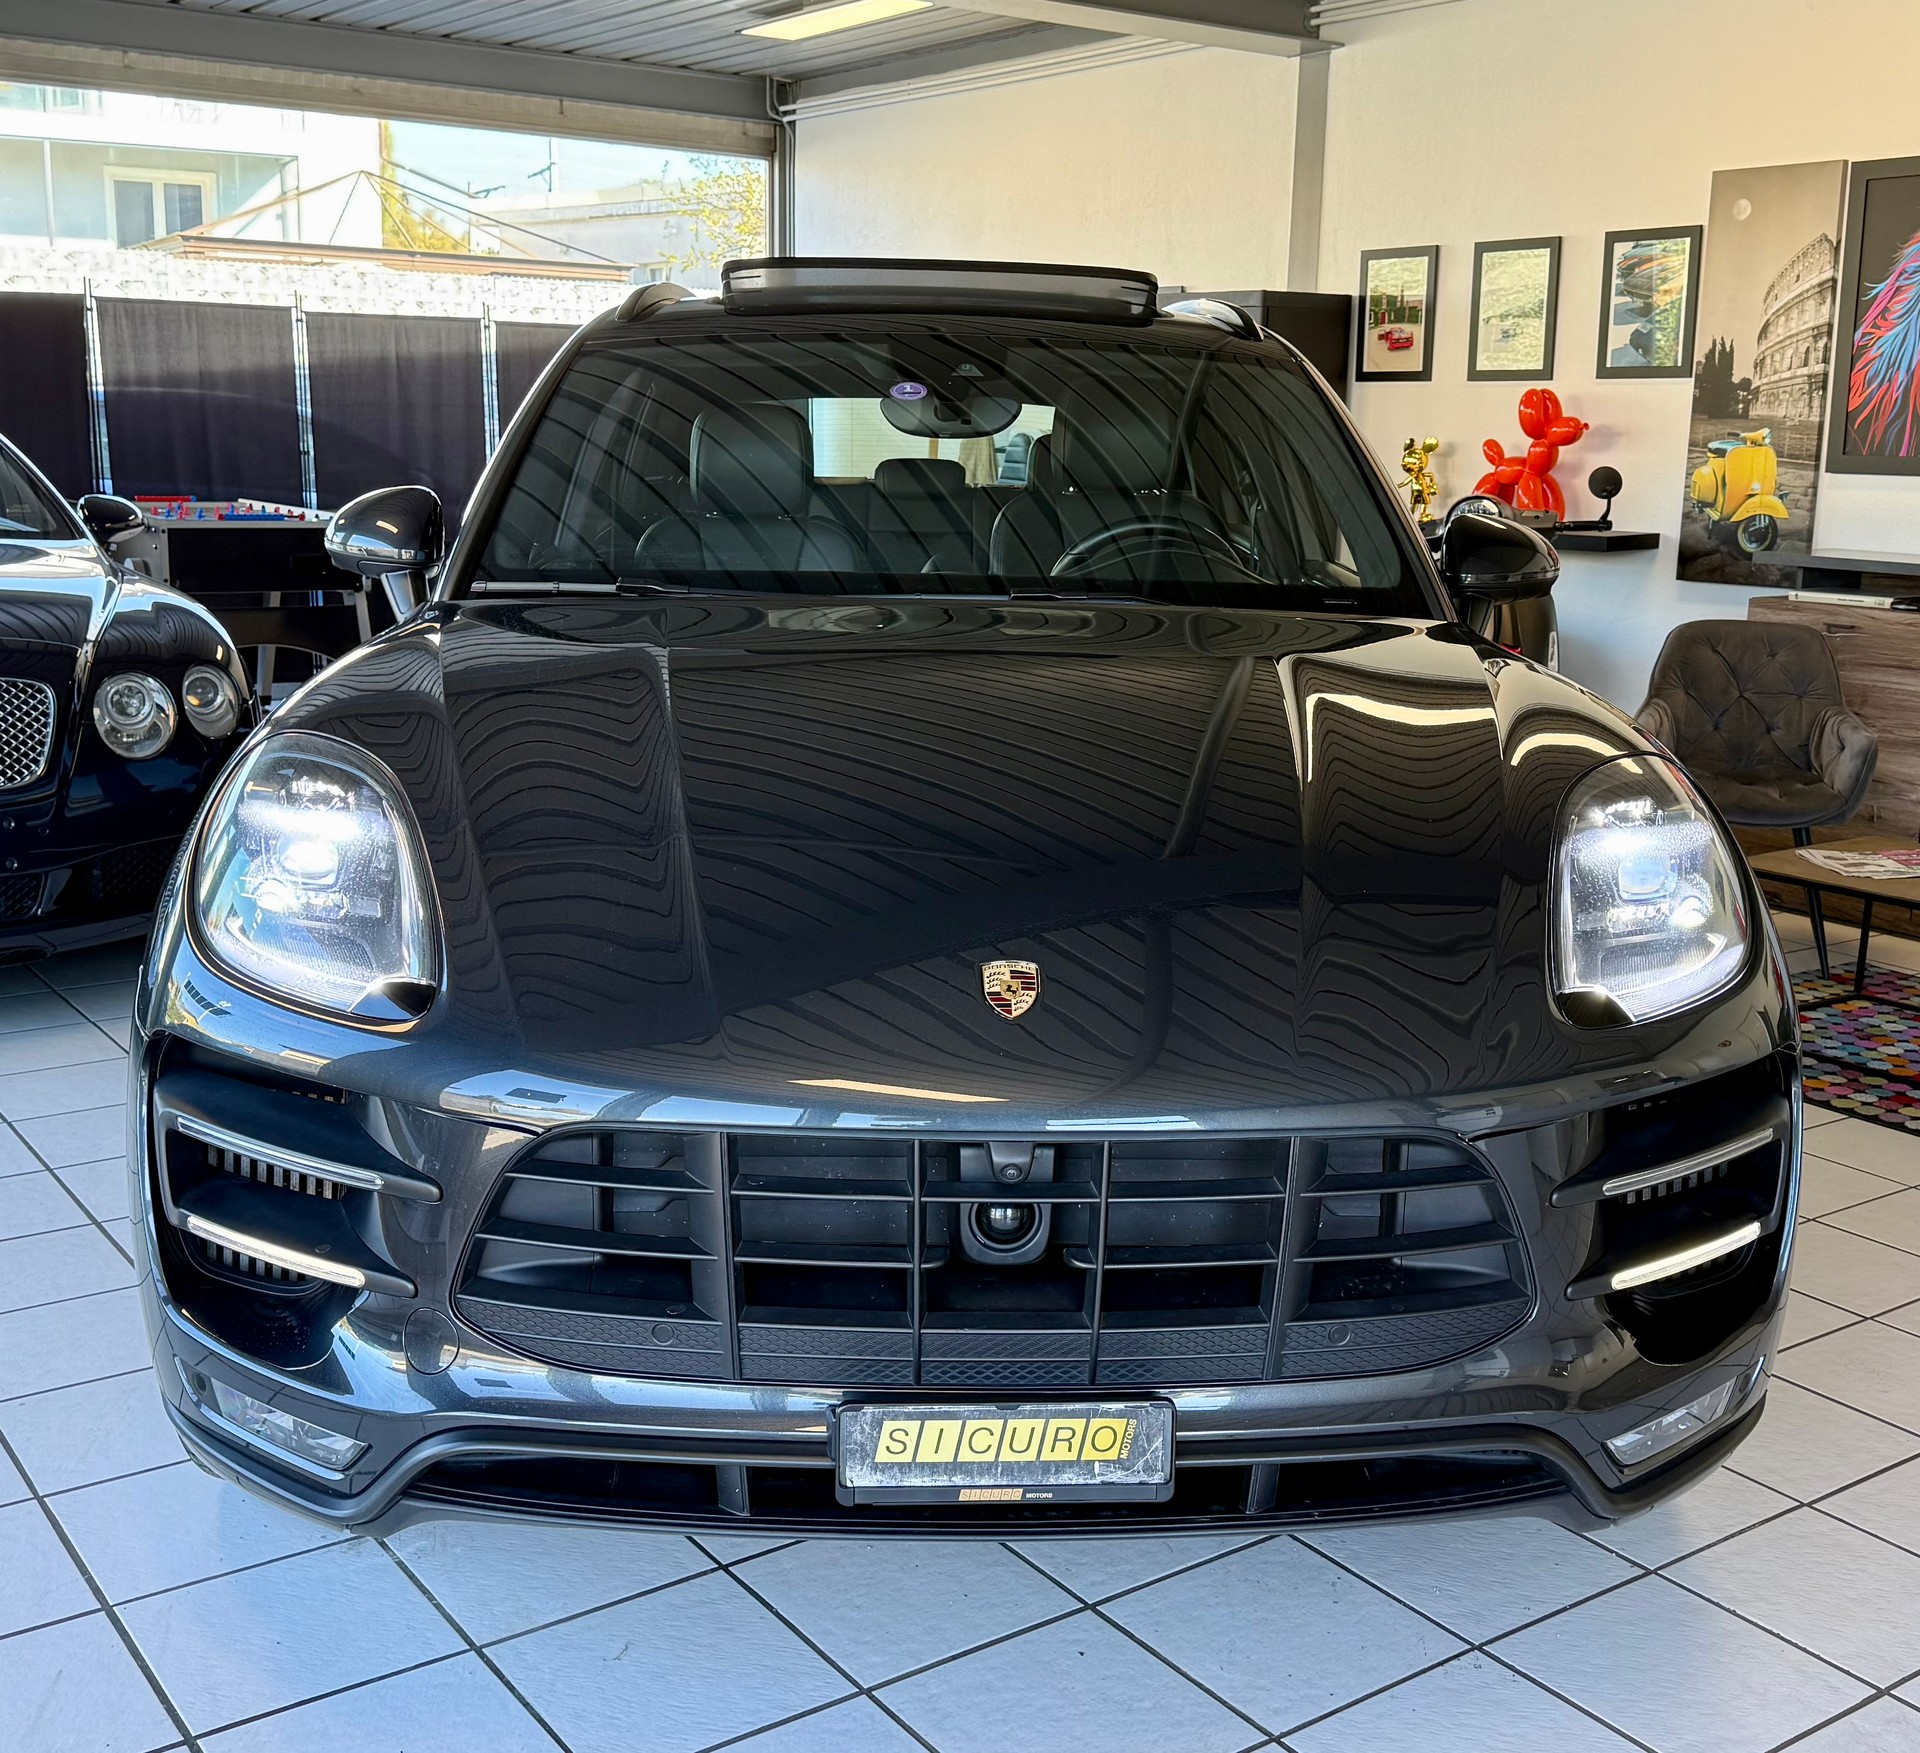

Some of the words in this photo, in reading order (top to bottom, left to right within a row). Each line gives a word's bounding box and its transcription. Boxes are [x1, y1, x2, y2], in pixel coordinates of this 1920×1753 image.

[983, 963, 1035, 972] PORSCHE
[885, 1424, 1118, 1455] SICURO
[1119, 1417, 1138, 1460] MOTORS
[961, 1490, 1021, 1499] SICURO
